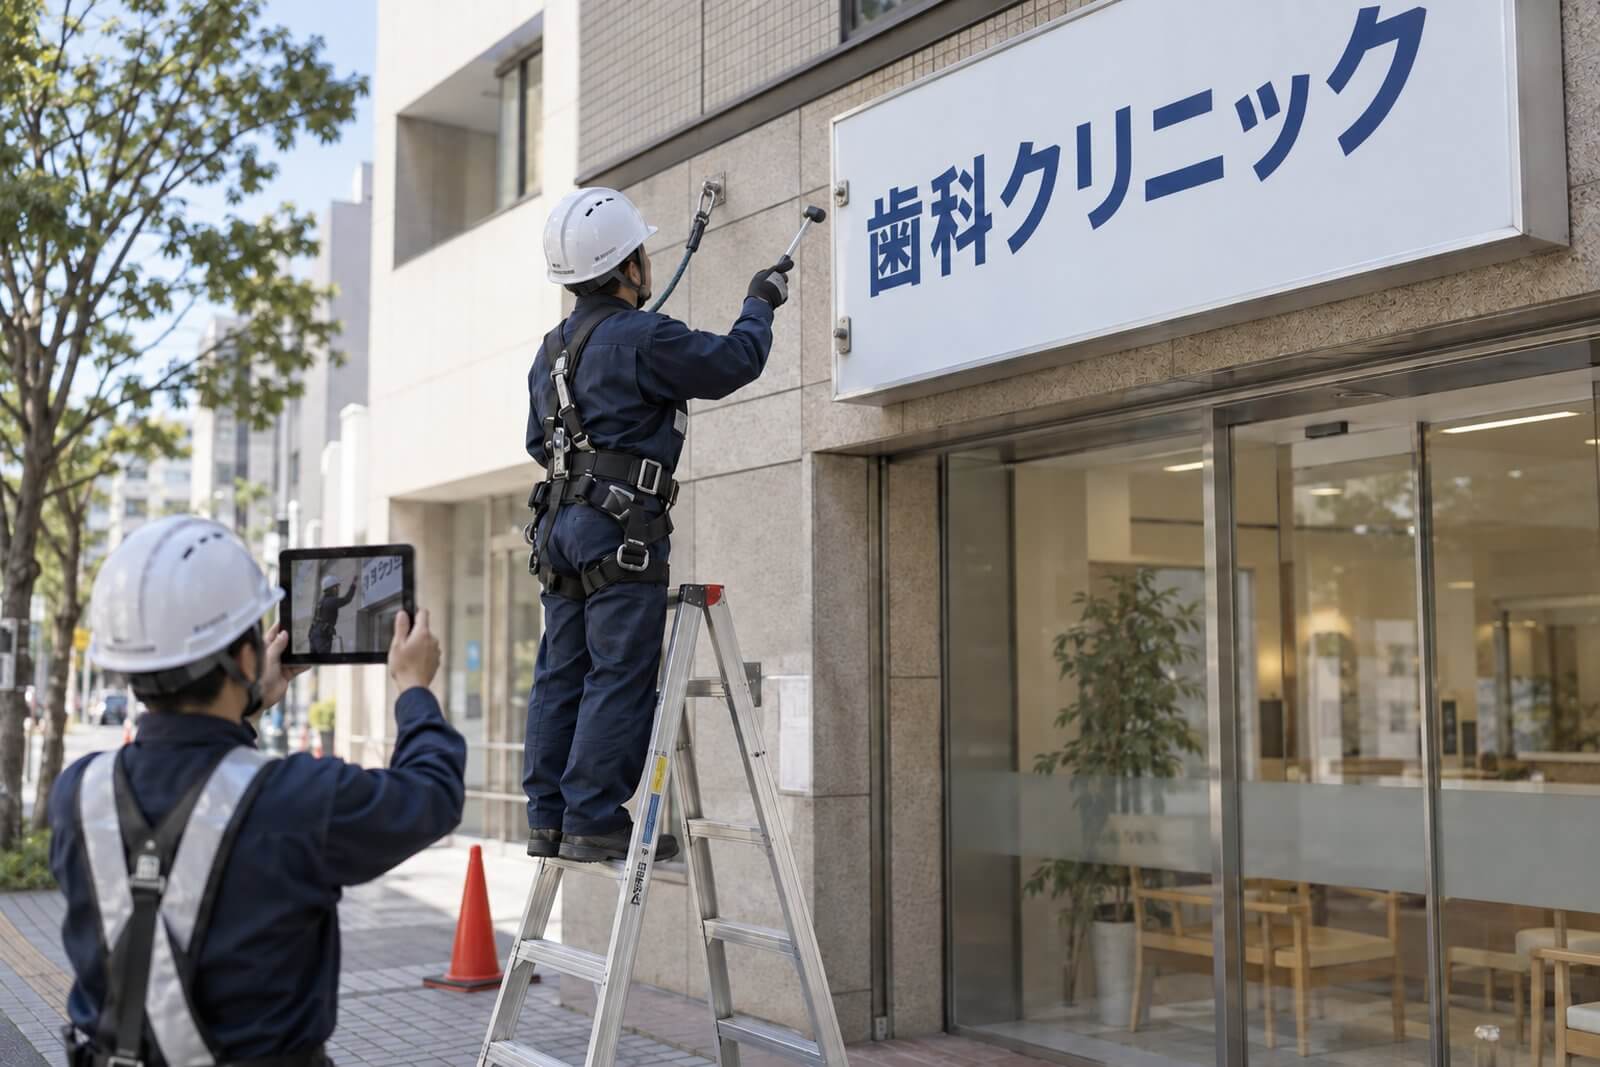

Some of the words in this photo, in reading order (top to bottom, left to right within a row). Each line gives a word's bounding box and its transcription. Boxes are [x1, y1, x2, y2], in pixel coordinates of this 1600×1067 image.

[868, 6, 1426, 297] 歯科クリニック
